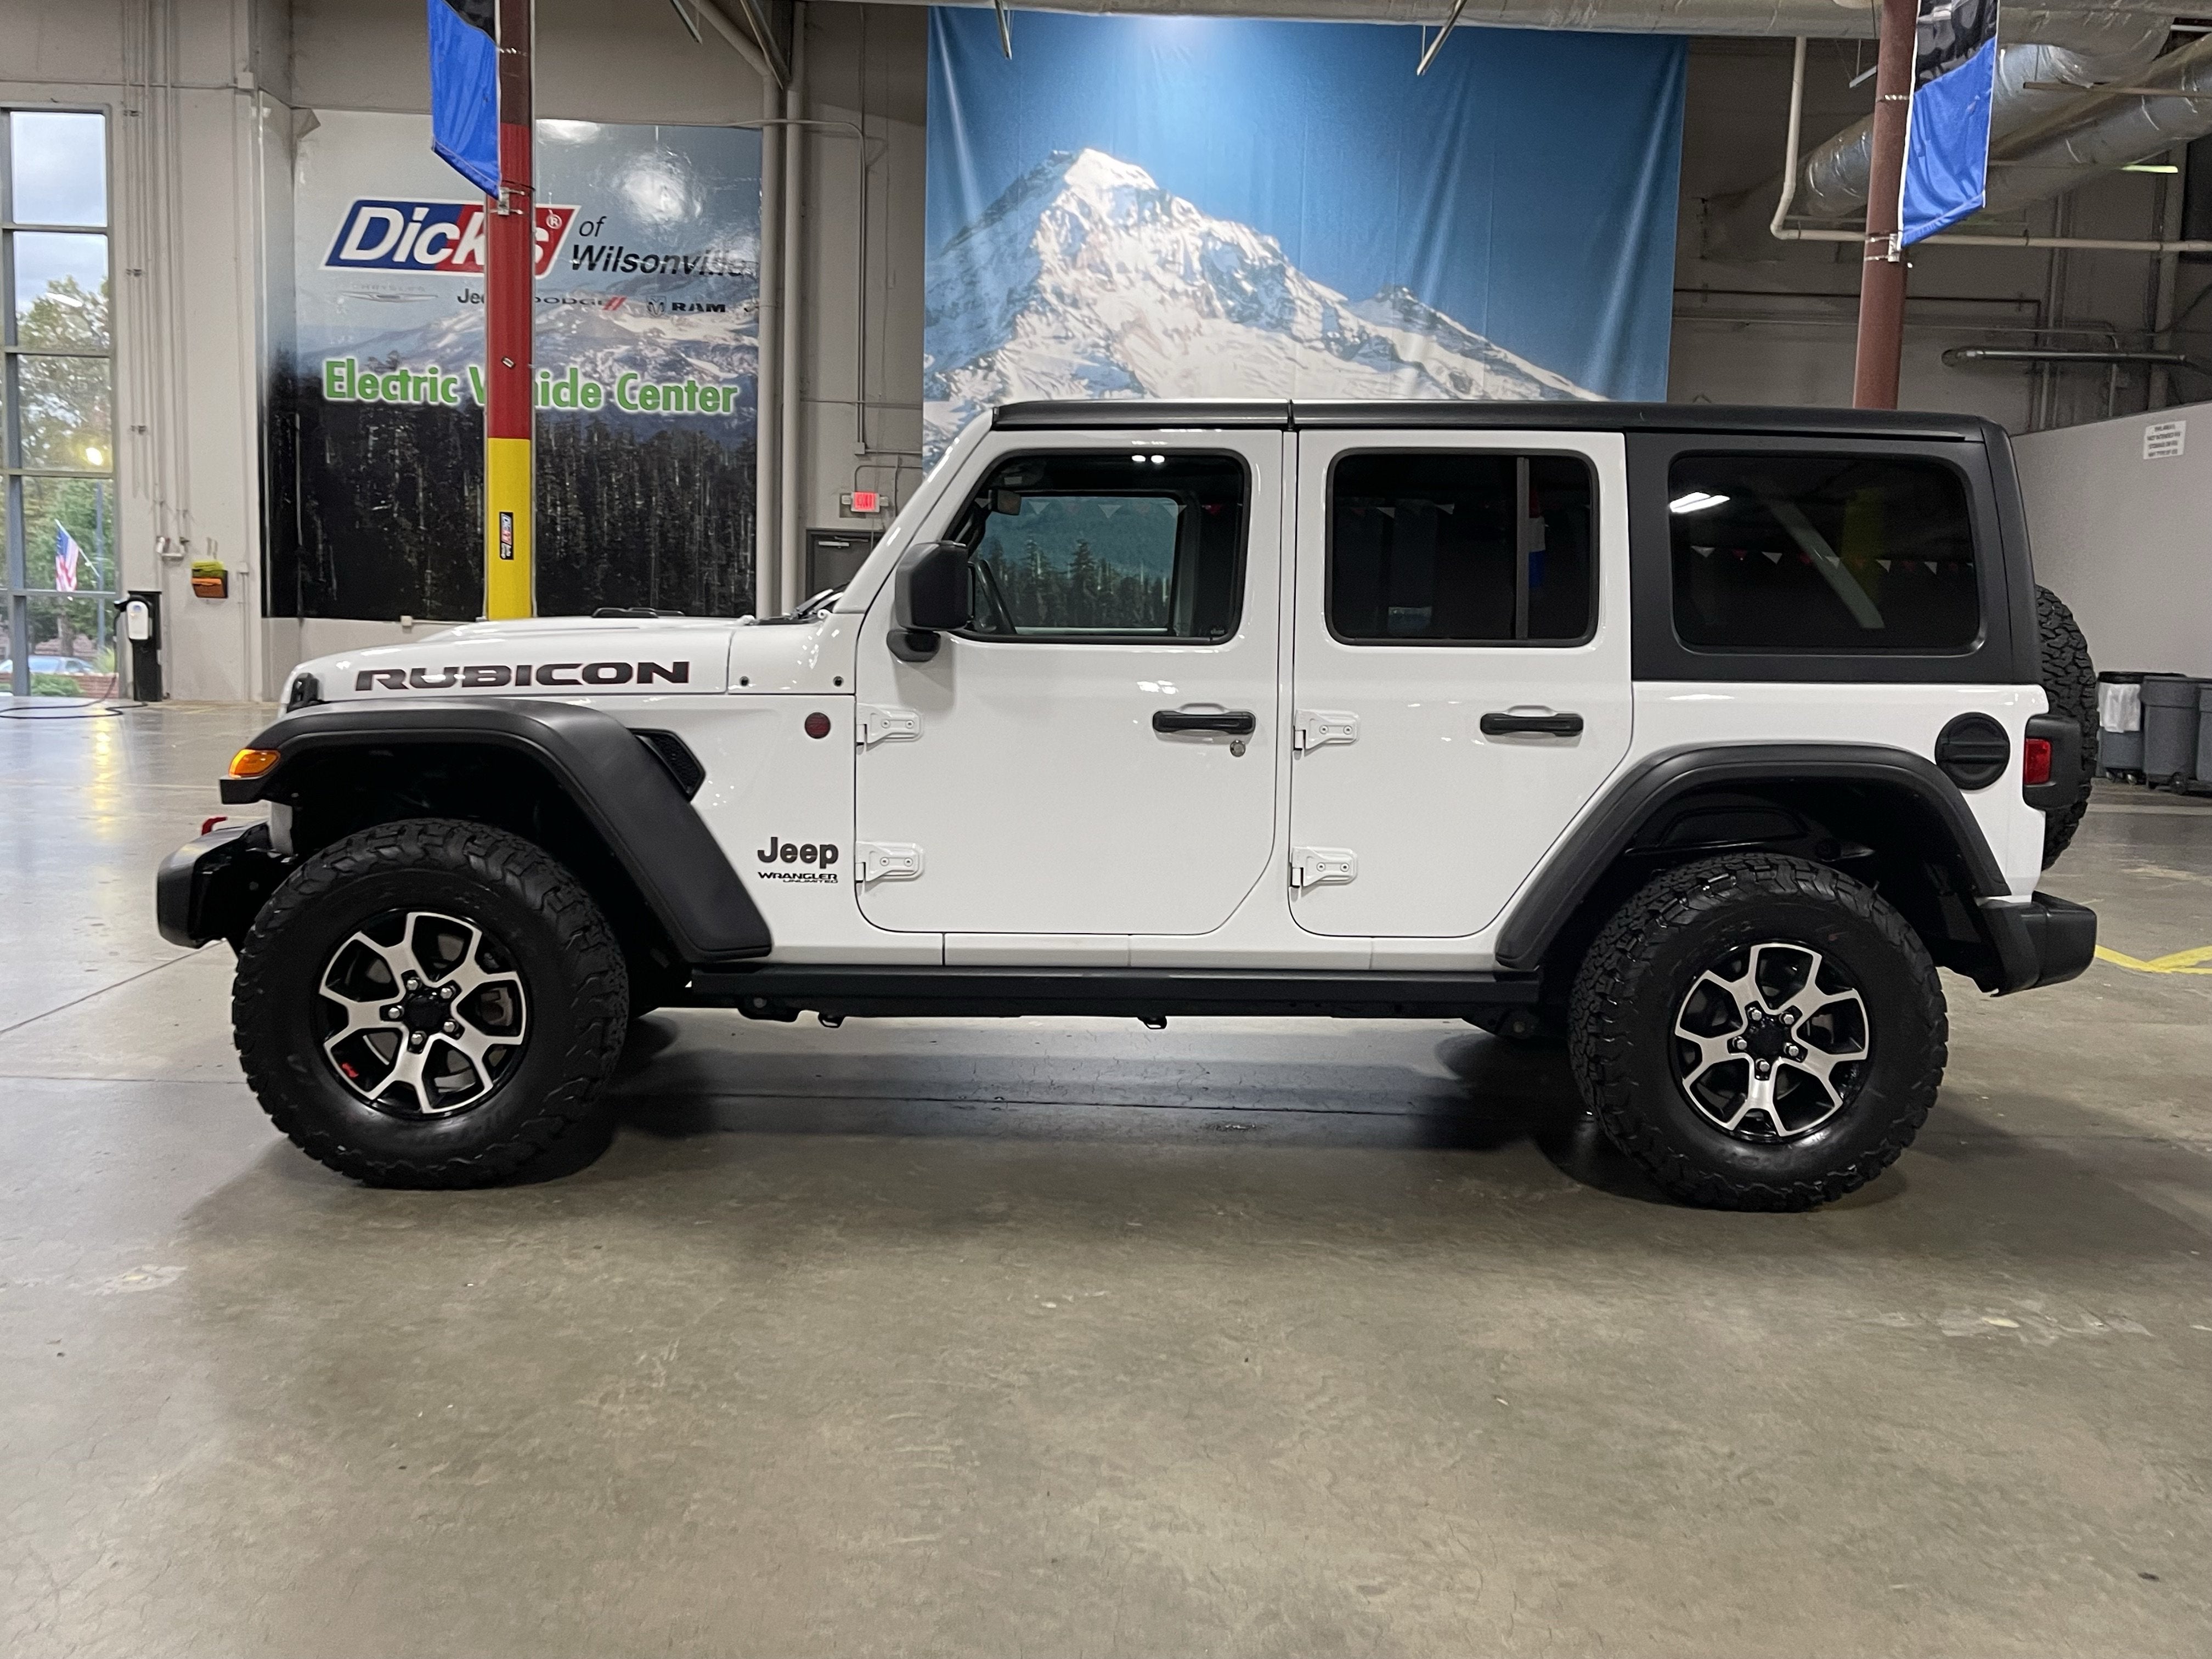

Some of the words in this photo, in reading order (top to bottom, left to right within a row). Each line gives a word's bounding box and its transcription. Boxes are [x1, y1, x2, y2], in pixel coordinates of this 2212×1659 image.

[340, 206, 549, 266] Dick
[579, 216, 607, 237] of
[572, 245, 749, 277] Wilsonvi
[458, 288, 485, 304] Je
[534, 296, 602, 305] ODG
[672, 302, 726, 313] RAM
[326, 358, 458, 403] Electric
[469, 366, 602, 408] Vicle
[617, 373, 738, 413] Center
[355, 661, 690, 691] RUBICON
[758, 837, 839, 869] Jeep
[758, 872, 838, 880] WRANGLER
